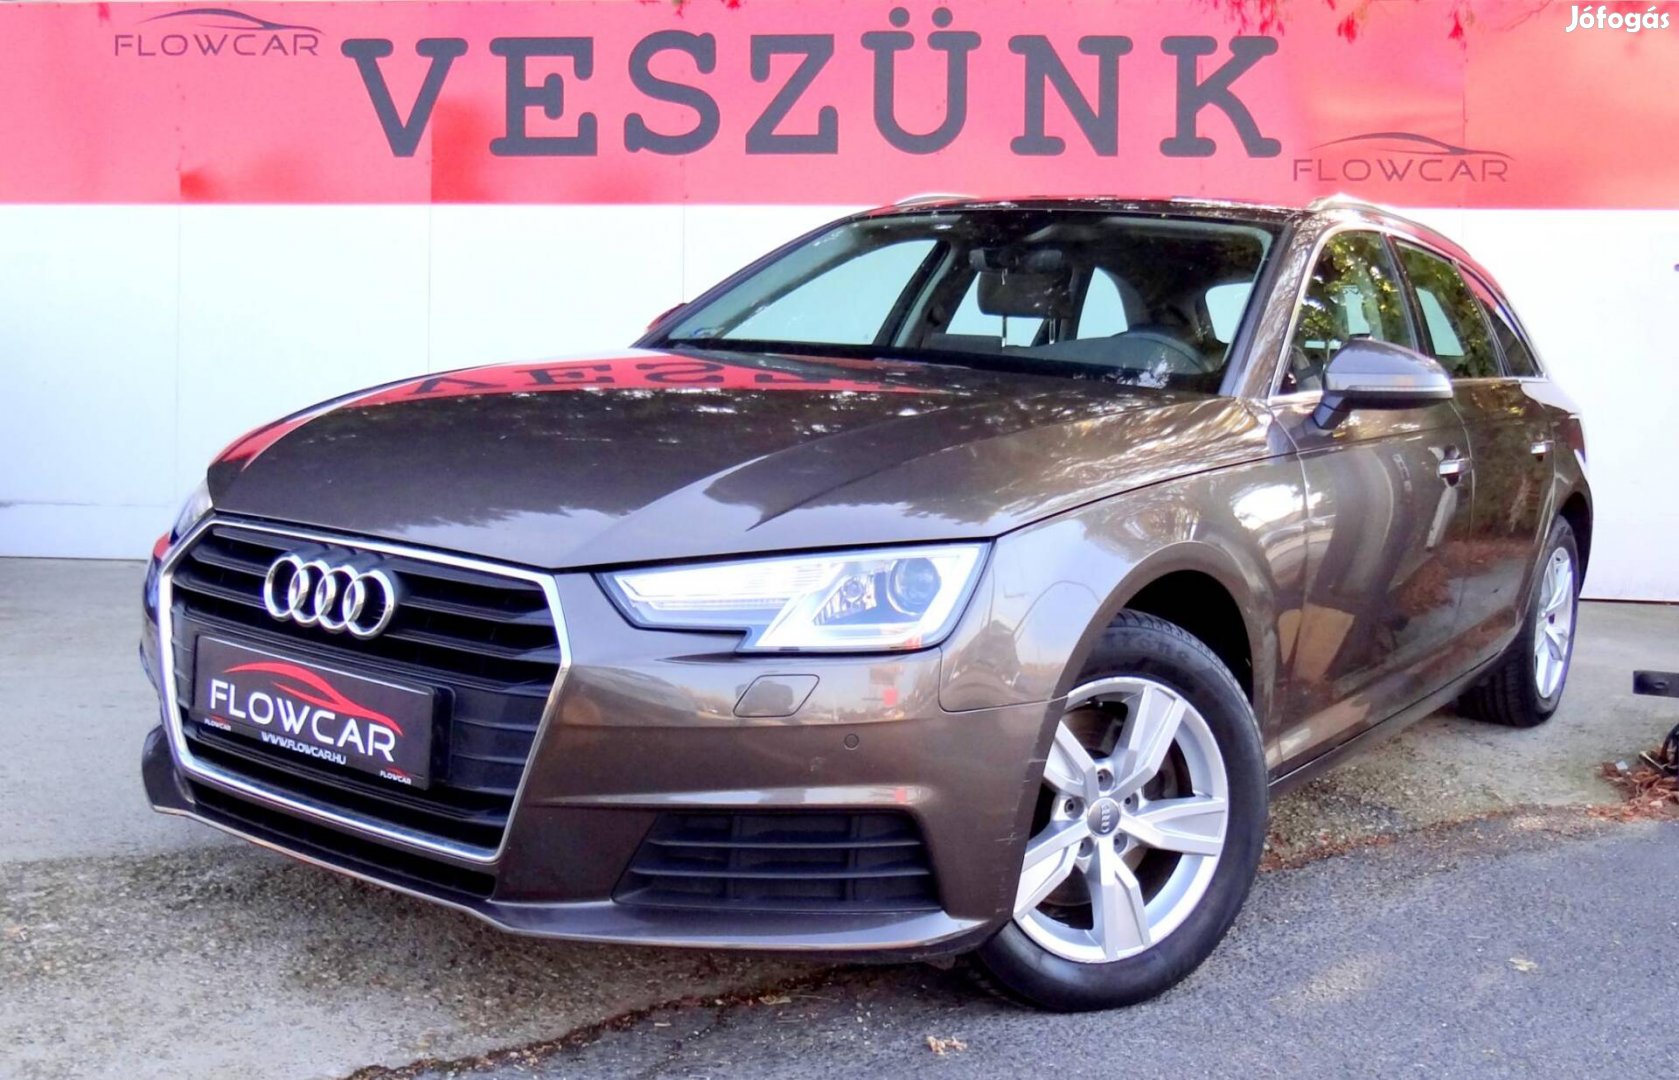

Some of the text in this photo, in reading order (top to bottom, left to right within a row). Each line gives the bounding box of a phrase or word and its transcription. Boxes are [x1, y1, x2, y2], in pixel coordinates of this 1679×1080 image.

[114, 33, 319, 56] FLOWCAR
[341, 7, 1282, 158] VESZÜNK
[1294, 160, 1508, 183] FLOWCAR
[210, 679, 396, 762] FLOWCAR
[261, 731, 347, 765] WWW.FLOWCAR.HU
[380, 770, 412, 785] FLOWCAR
